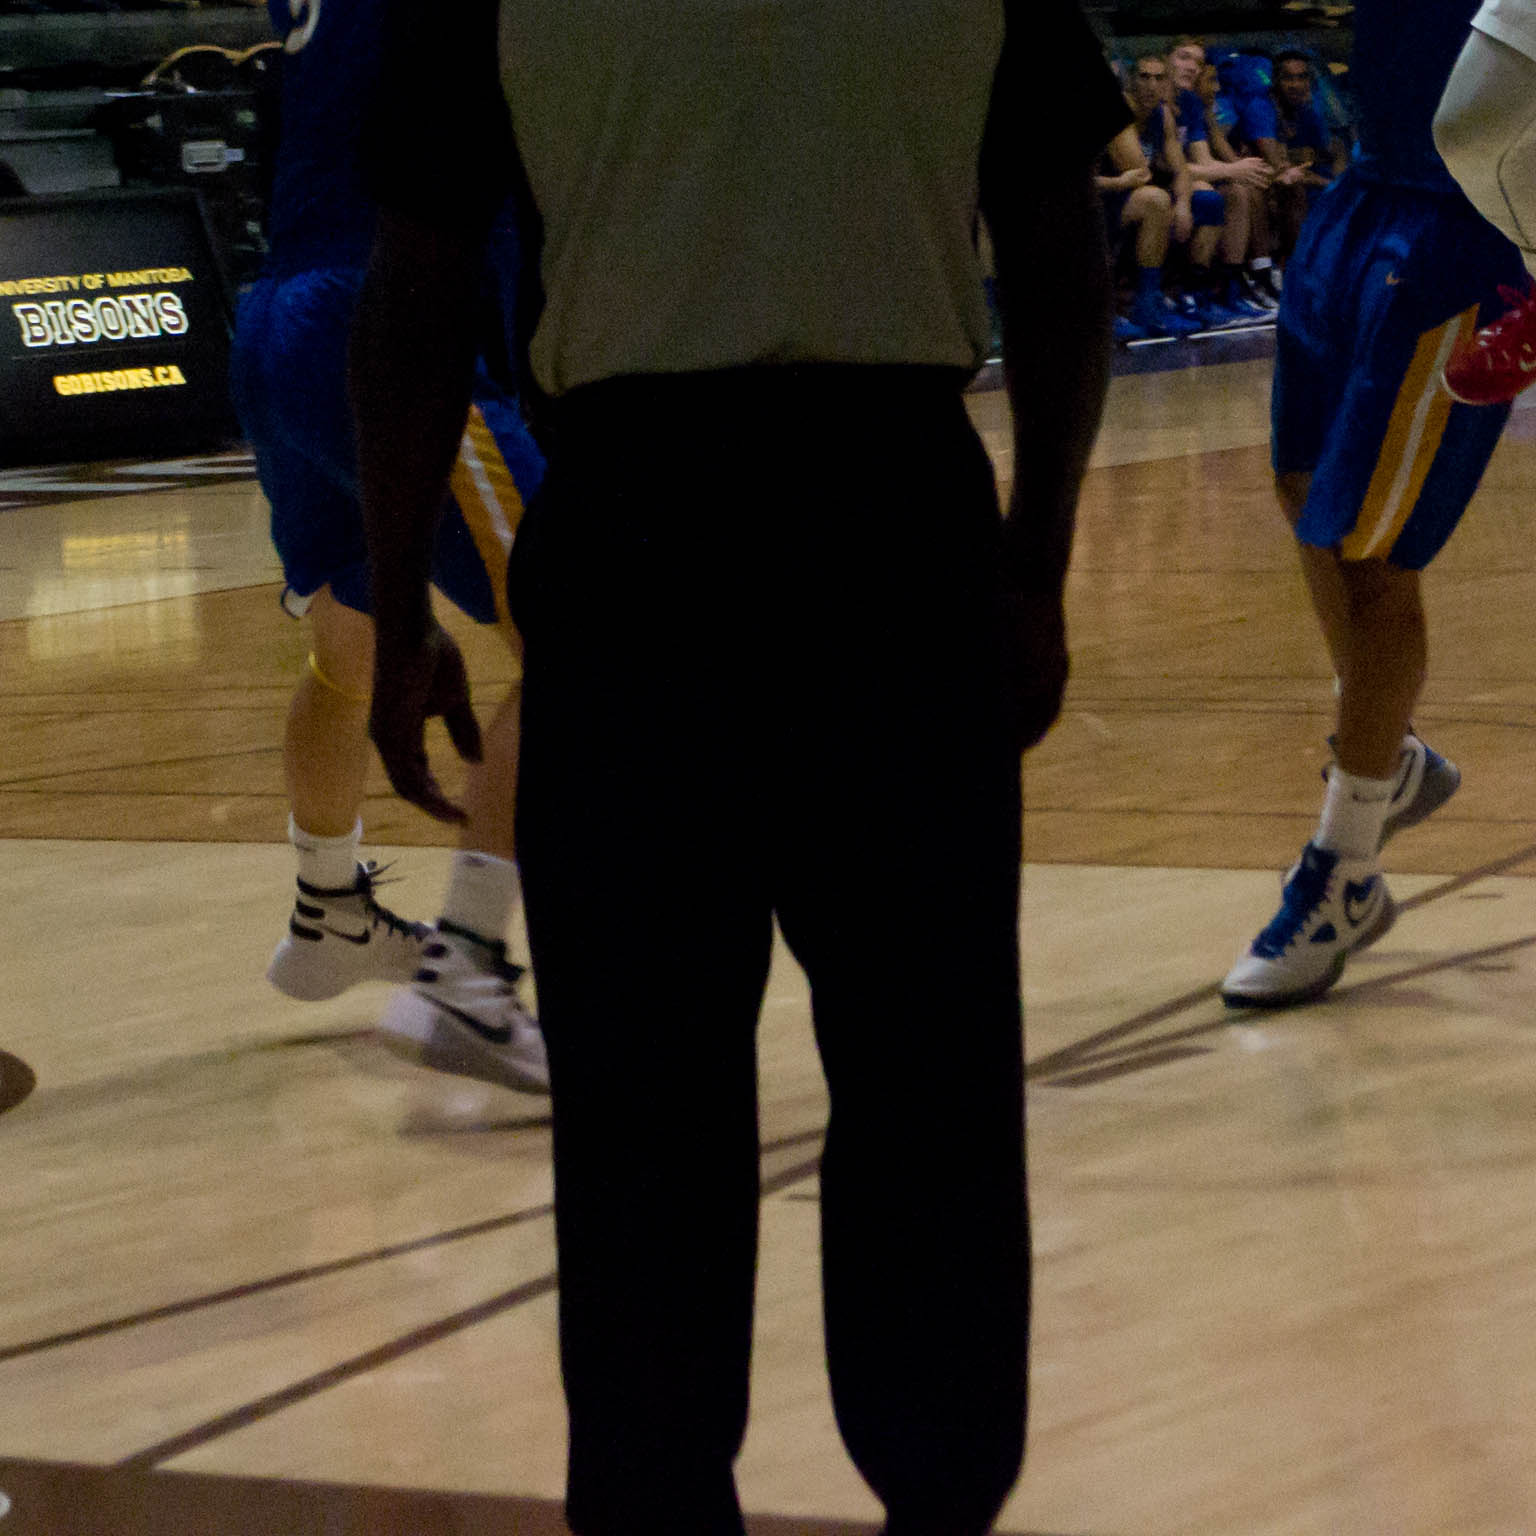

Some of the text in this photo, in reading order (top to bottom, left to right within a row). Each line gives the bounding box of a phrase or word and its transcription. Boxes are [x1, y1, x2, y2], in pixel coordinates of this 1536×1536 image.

[81, 272, 106, 291] OF
[105, 266, 196, 288] MANITOBA
[11, 291, 190, 349] BISONS
[52, 363, 188, 397] GOBISONS.CA
